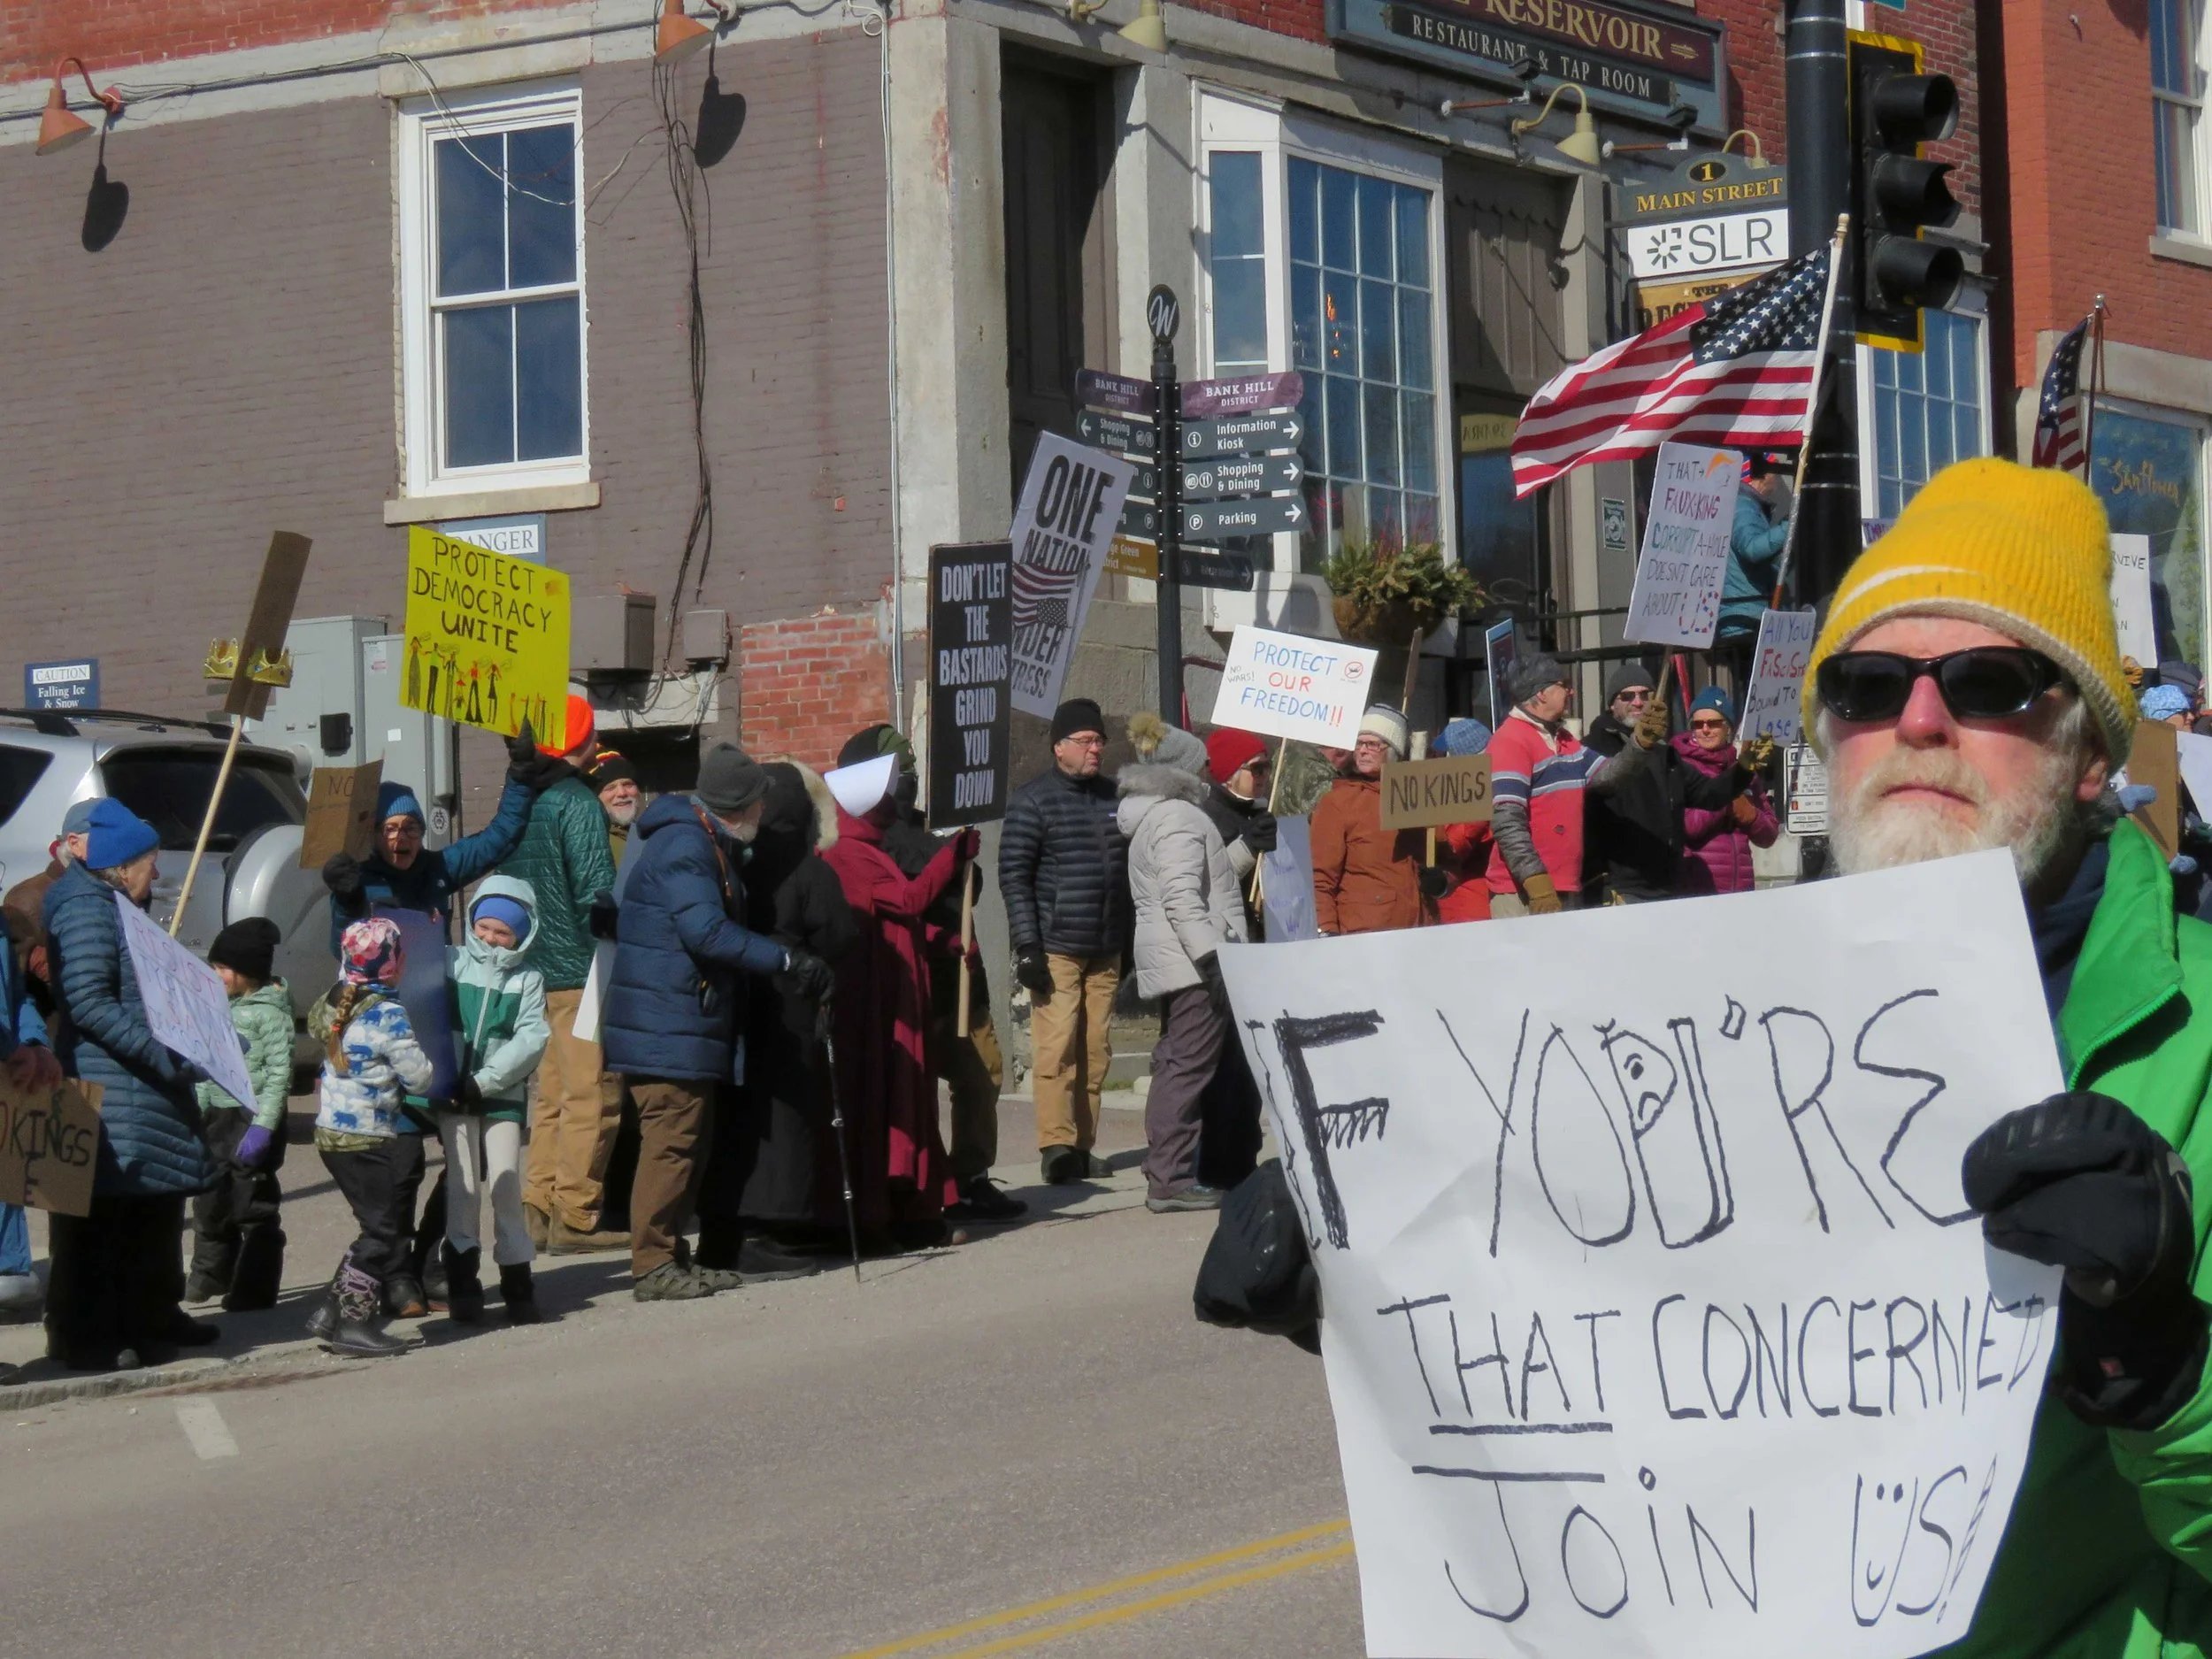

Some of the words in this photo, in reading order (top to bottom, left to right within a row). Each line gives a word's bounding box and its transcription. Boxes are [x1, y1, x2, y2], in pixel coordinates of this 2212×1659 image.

[1485, 0, 1664, 60] RESERVOIR
[1413, 15, 1529, 60] RESTAURANT
[1538, 50, 1549, 72] &
[1561, 56, 1591, 81] TAP
[1601, 69, 1651, 97] ROOM
[1701, 163, 1715, 181] 1
[1636, 189, 1696, 212] MAIN
[1702, 177, 1784, 204] STREET
[1688, 218, 1774, 265] SLR
[1095, 379, 1118, 392] BANK
[1120, 383, 1139, 396] HILL
[1206, 385, 1240, 397] BANK
[1245, 381, 1274, 394] HILL
[1221, 396, 1259, 407] DISTRICT
[1100, 418, 1130, 436] Shopping
[1107, 434, 1128, 451] Dining
[1217, 419, 1277, 435] Information
[1217, 438, 1244, 450] Kiosk
[1217, 463, 1263, 477] Shopping
[1218, 482, 1225, 491] &
[1229, 479, 1260, 491] Dining
[1667, 461, 1700, 480] THAT
[1035, 455, 1115, 545] ONE
[1219, 512, 1256, 526] Parking
[1022, 528, 1091, 573] NATION
[1652, 522, 1700, 557] CORRUPT
[1694, 534, 1729, 558] A-HOLE
[432, 536, 534, 595] PROTECT
[1690, 565, 1718, 588] CARE
[2111, 550, 2147, 570] RVIVE
[412, 567, 551, 633] DEMOCRACY
[941, 564, 985, 603] DON'T
[987, 563, 1006, 599] LET
[964, 605, 989, 642] THE
[1642, 592, 1682, 617] ABOUT
[1678, 589, 1719, 635] US
[442, 611, 518, 654] UNITE
[1012, 623, 1064, 665] NDER
[1763, 617, 1781, 643] All
[35, 666, 88, 682] CAUTION
[939, 644, 1008, 687] BASTARDS
[1230, 664, 1241, 674] NO
[1254, 641, 1338, 676] PROTECT
[38, 686, 70, 699] Falling
[73, 685, 86, 695] Ice
[1012, 657, 1052, 699] TRESS
[1227, 672, 1256, 684] WARS!
[1269, 672, 1312, 693] OUR
[56, 698, 80, 709] Snow
[956, 687, 996, 726] GRIND
[1240, 687, 1343, 727] FREEDOM!!
[1747, 683, 1780, 714] Bound
[964, 728, 989, 767] YOU
[955, 769, 995, 810] DOWN
[1390, 777, 1417, 815] NO
[1425, 771, 1486, 809] KINGS
[9, 1107, 93, 1167] KINGS
[1243, 1008, 1389, 1250] IF
[1377, 1294, 1621, 1421] THAT
[1652, 1292, 2045, 1421] CONCERNED
[1851, 1453, 1998, 1628] US!
